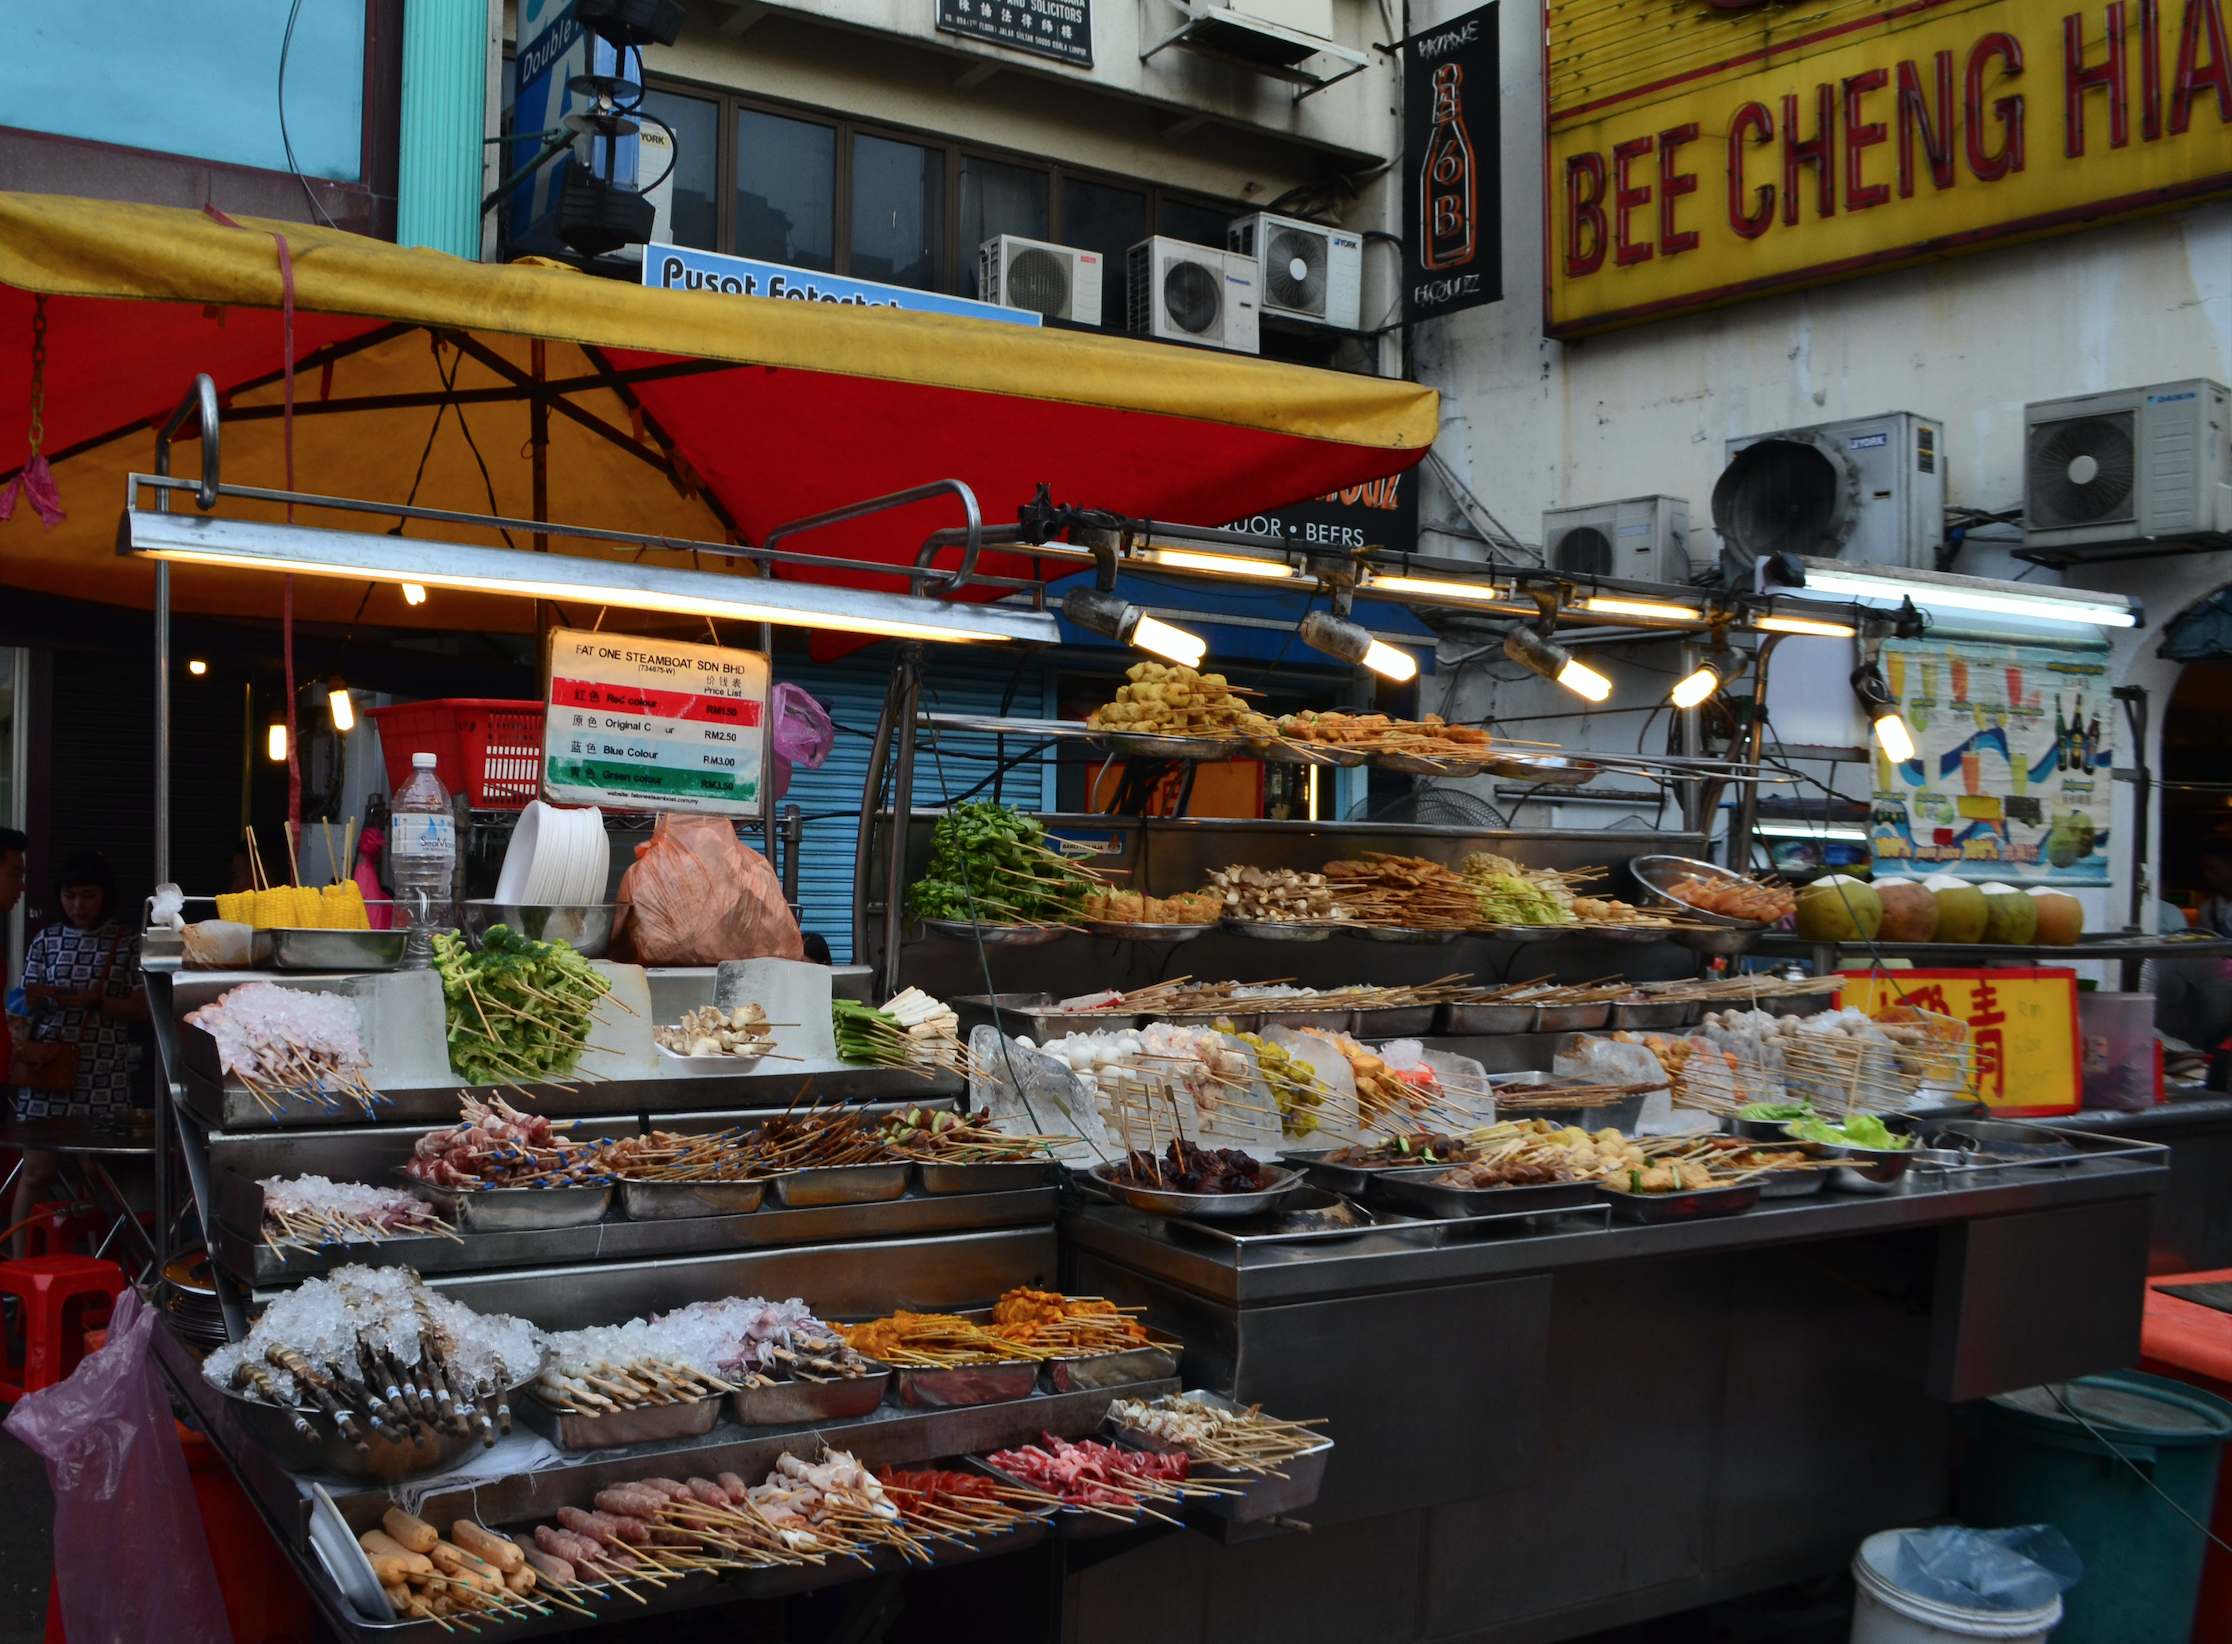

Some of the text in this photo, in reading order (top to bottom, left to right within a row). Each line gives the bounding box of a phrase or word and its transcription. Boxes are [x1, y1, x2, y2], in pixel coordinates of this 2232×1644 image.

[1031, 0, 1082, 23] SOLICITORS
[522, 18, 571, 85] Double
[641, 132, 664, 145] YORK
[1563, 122, 1700, 279] BEE
[1726, 31, 2025, 240] CHENG
[1339, 238, 1358, 250] YORK
[1225, 275, 1251, 287] Panasonic
[575, 644, 745, 675] FAT ONE STEAMBOAT SDN BHD
[704, 686, 742, 698] Price List
[706, 675, 742, 689] 价钱表
[574, 688, 600, 703] 红色
[606, 693, 626, 704] Red
[628, 695, 657, 708] colour
[572, 714, 598, 728] 原色
[605, 718, 641, 731] Original
[704, 730, 737, 742] RM2.50
[571, 740, 736, 767] 蓝色 Blue Colour RM3.00
[602, 770, 631, 783] Green
[633, 772, 663, 785] colour
[701, 779, 734, 791] RM3.50
[1875, 837, 1912, 859] 100%
[1962, 839, 1999, 860] 100%
